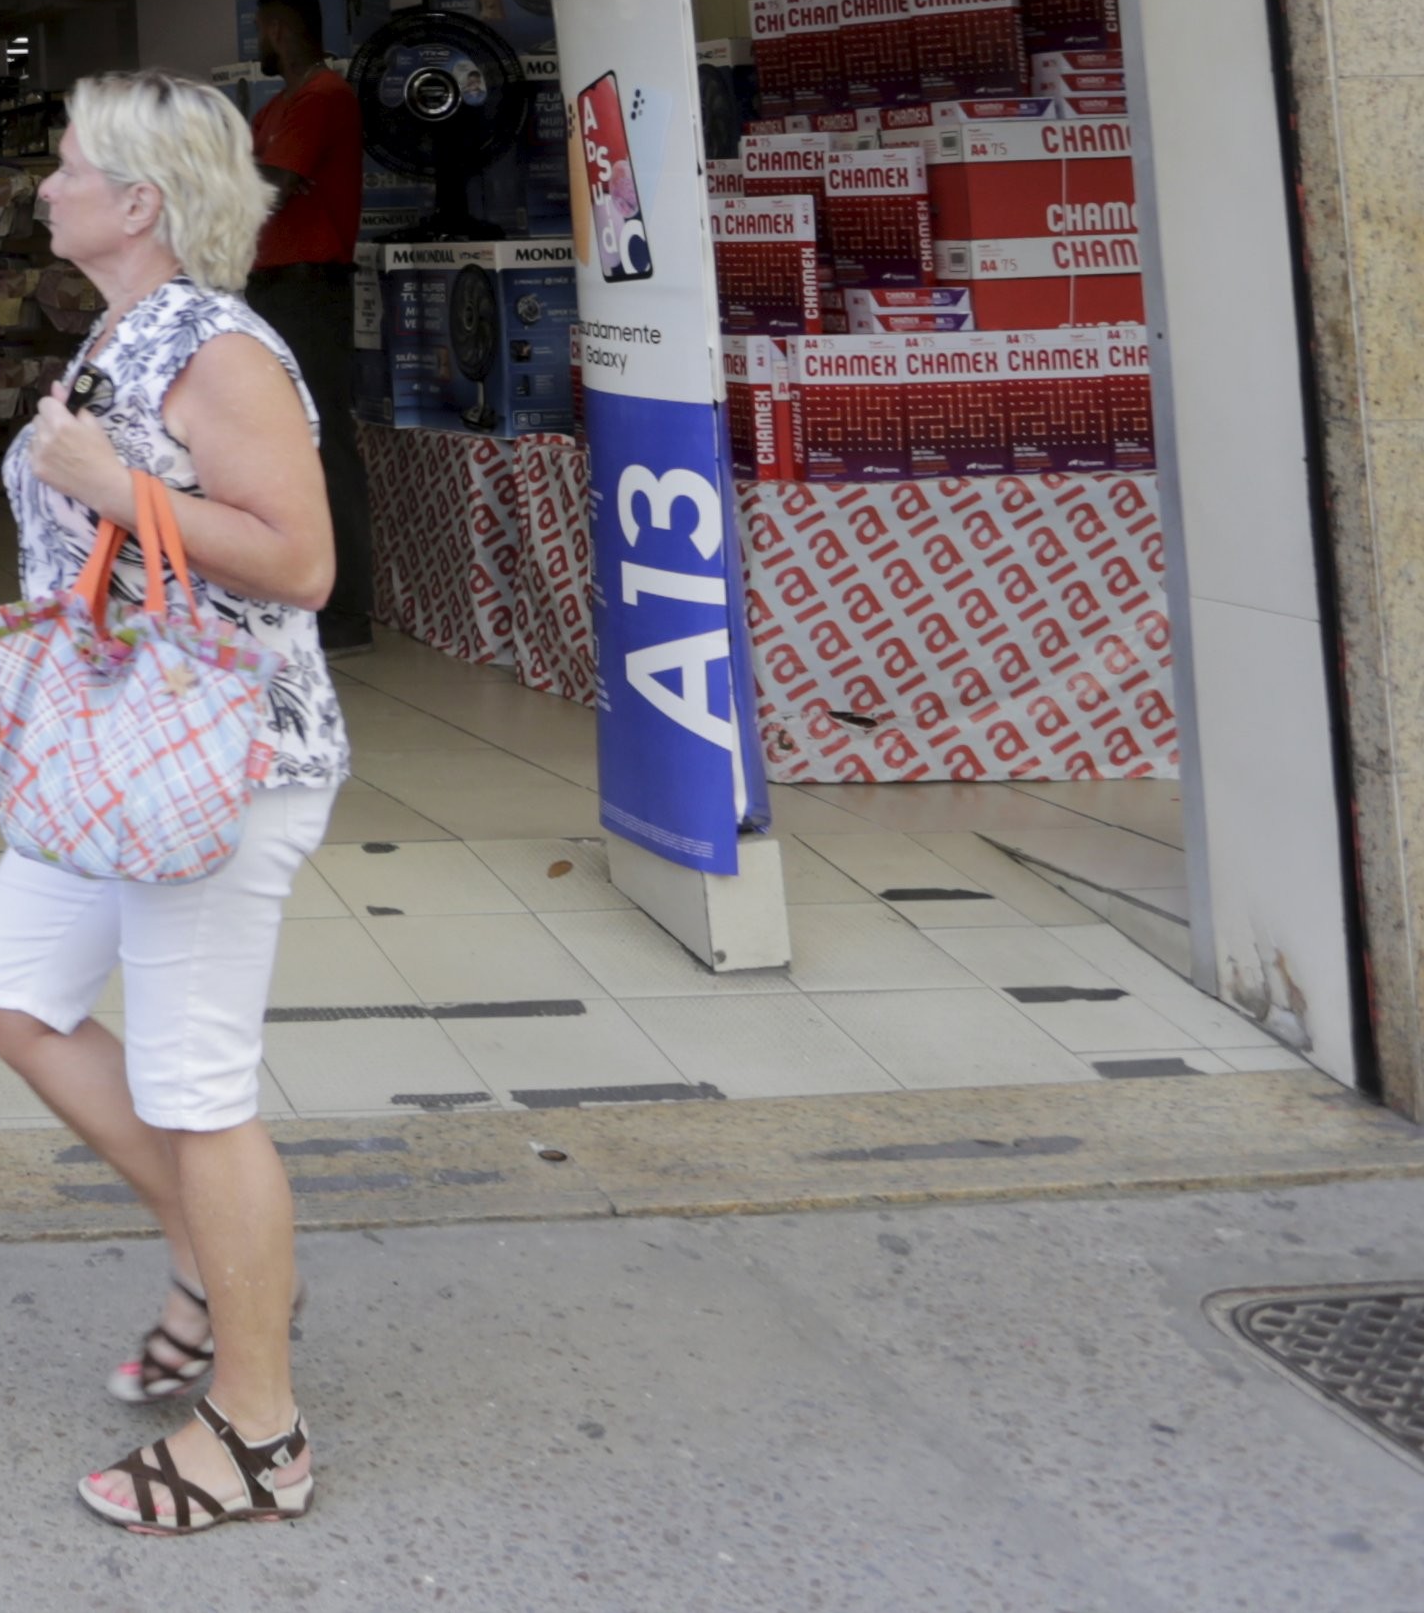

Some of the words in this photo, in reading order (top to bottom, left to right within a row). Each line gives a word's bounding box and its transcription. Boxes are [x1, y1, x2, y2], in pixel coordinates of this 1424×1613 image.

[745, 138, 758, 147] A4
[971, 143, 988, 156] A4
[990, 143, 1007, 156] 75
[1042, 122, 1131, 154] CHAM
[746, 150, 825, 172] CHAMEX
[828, 154, 840, 164] A4
[829, 167, 909, 190] CHAMEX
[725, 199, 736, 209] A4
[725, 212, 794, 235] CHAMEX
[916, 200, 934, 272] CHAMEX
[980, 259, 998, 272] A4
[1000, 259, 1018, 272] 75
[801, 247, 819, 320] CHAMEX
[885, 291, 916, 301] CHAMEX
[804, 338, 818, 349] A4
[820, 338, 835, 349] 75
[905, 337, 919, 348] A4
[921, 337, 935, 348] 75
[1006, 334, 1020, 344] A4
[1023, 333, 1036, 344] 75
[1107, 329, 1121, 340] A4
[1124, 328, 1137, 339] 75
[586, 347, 628, 375] Galaxy
[805, 353, 897, 377] CHAMEX
[906, 350, 999, 376] CHAMEX
[1007, 347, 1100, 372] CHAMEX
[754, 389, 776, 465] CHAMEX
[617, 463, 733, 753] A13
